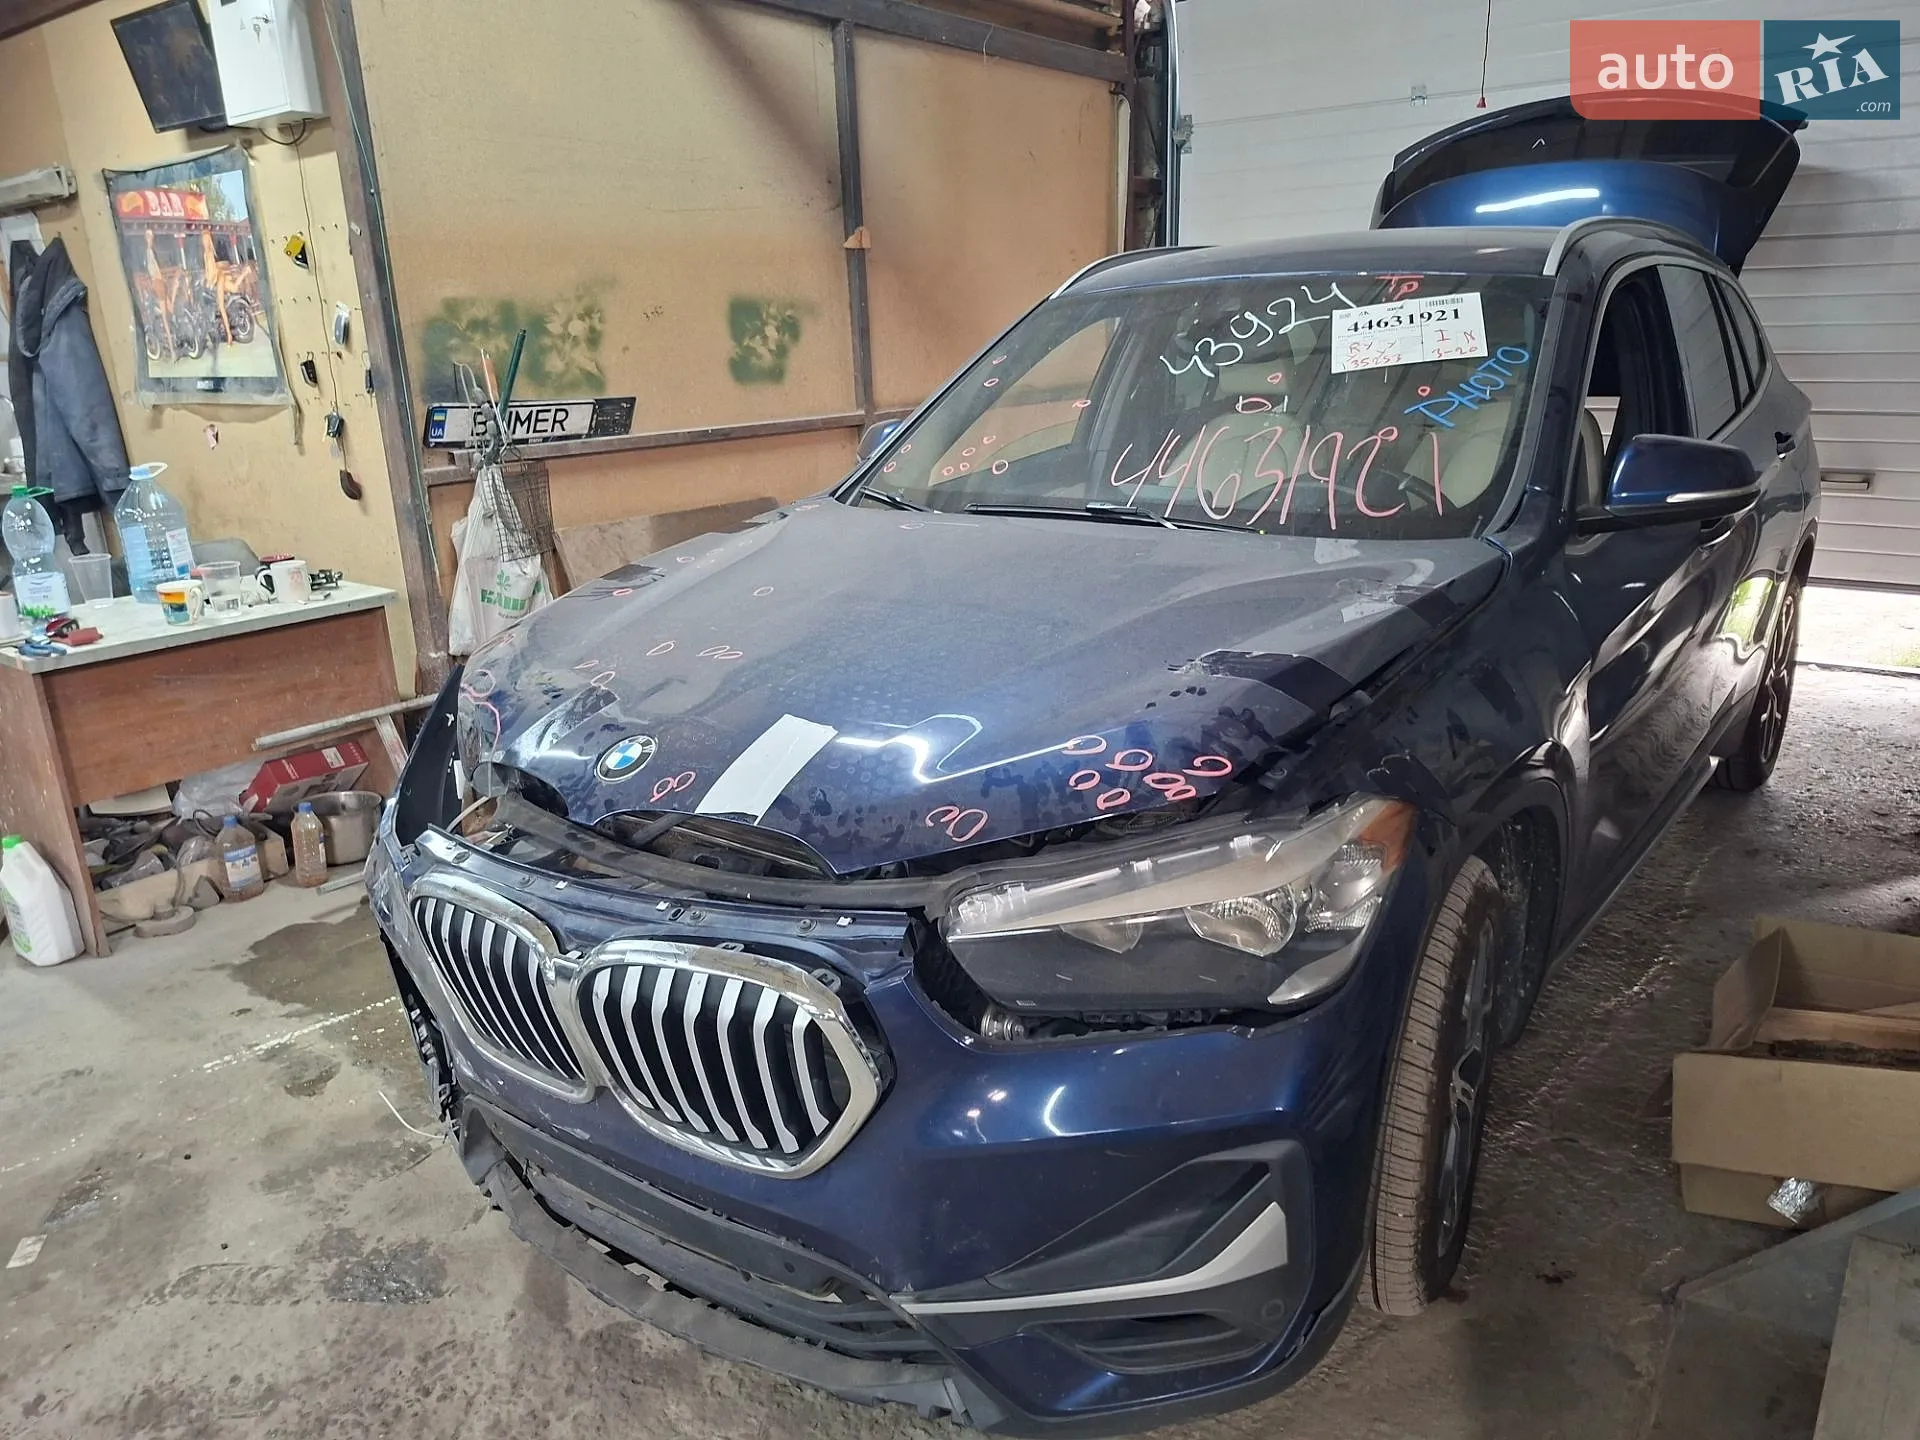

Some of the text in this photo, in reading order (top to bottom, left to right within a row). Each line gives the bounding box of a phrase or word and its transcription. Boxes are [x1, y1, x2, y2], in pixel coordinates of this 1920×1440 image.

[1160, 282, 1357, 378] 43924
[1347, 308, 1461, 333] 44631921
[1403, 346, 1530, 429] PHOTO
[431, 427, 443, 437] UA
[471, 407, 569, 437] BMER
[1111, 425, 1444, 531] 44631921
